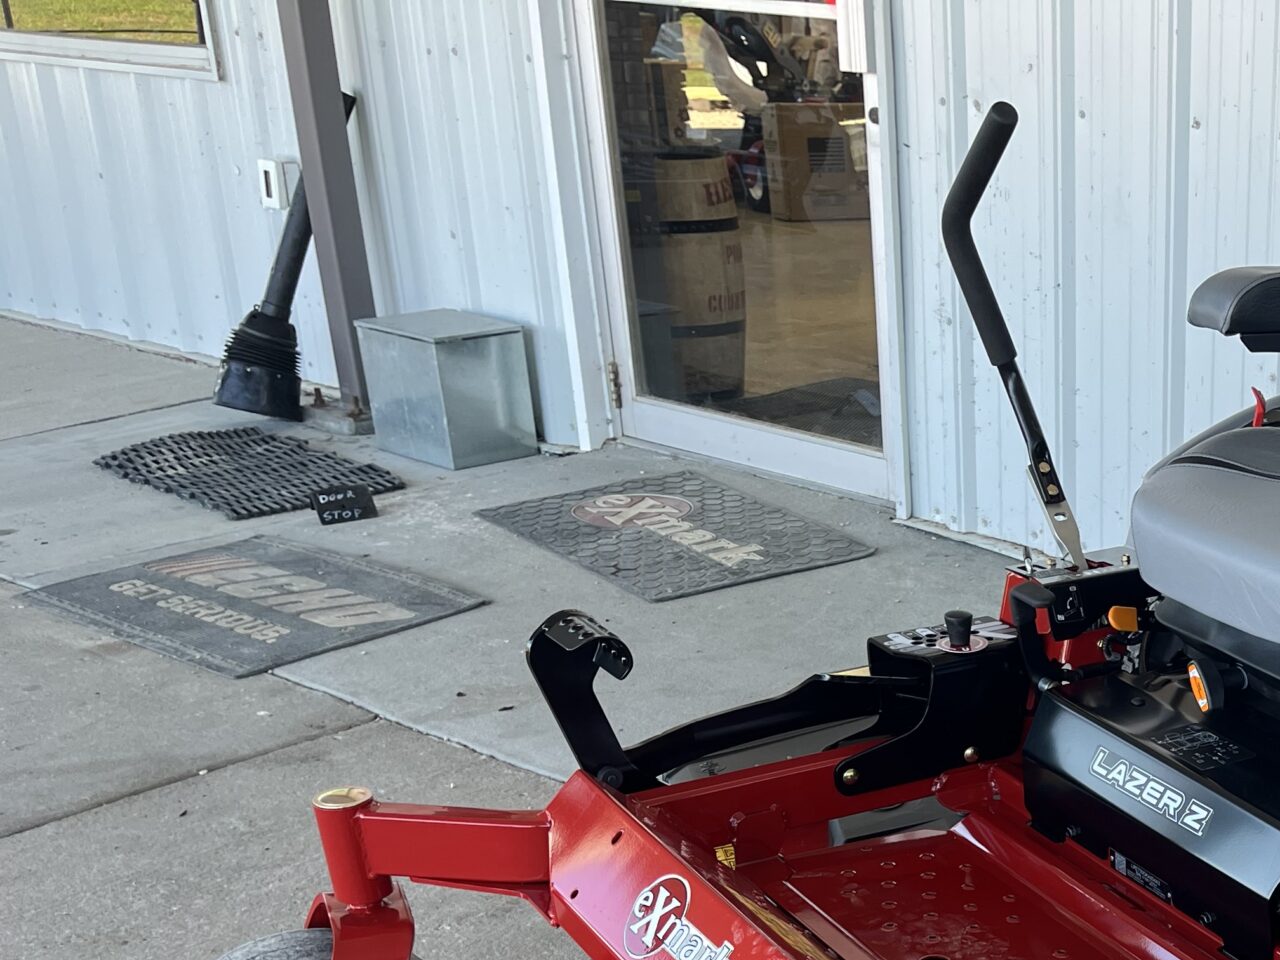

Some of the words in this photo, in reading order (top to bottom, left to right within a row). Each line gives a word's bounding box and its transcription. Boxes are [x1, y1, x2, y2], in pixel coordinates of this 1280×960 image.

[323, 508, 361, 521] STOP
[108, 579, 175, 600] GET
[165, 558, 416, 628] ECHO
[1090, 747, 1185, 822] LAZER
[1180, 800, 1212, 835] Z
